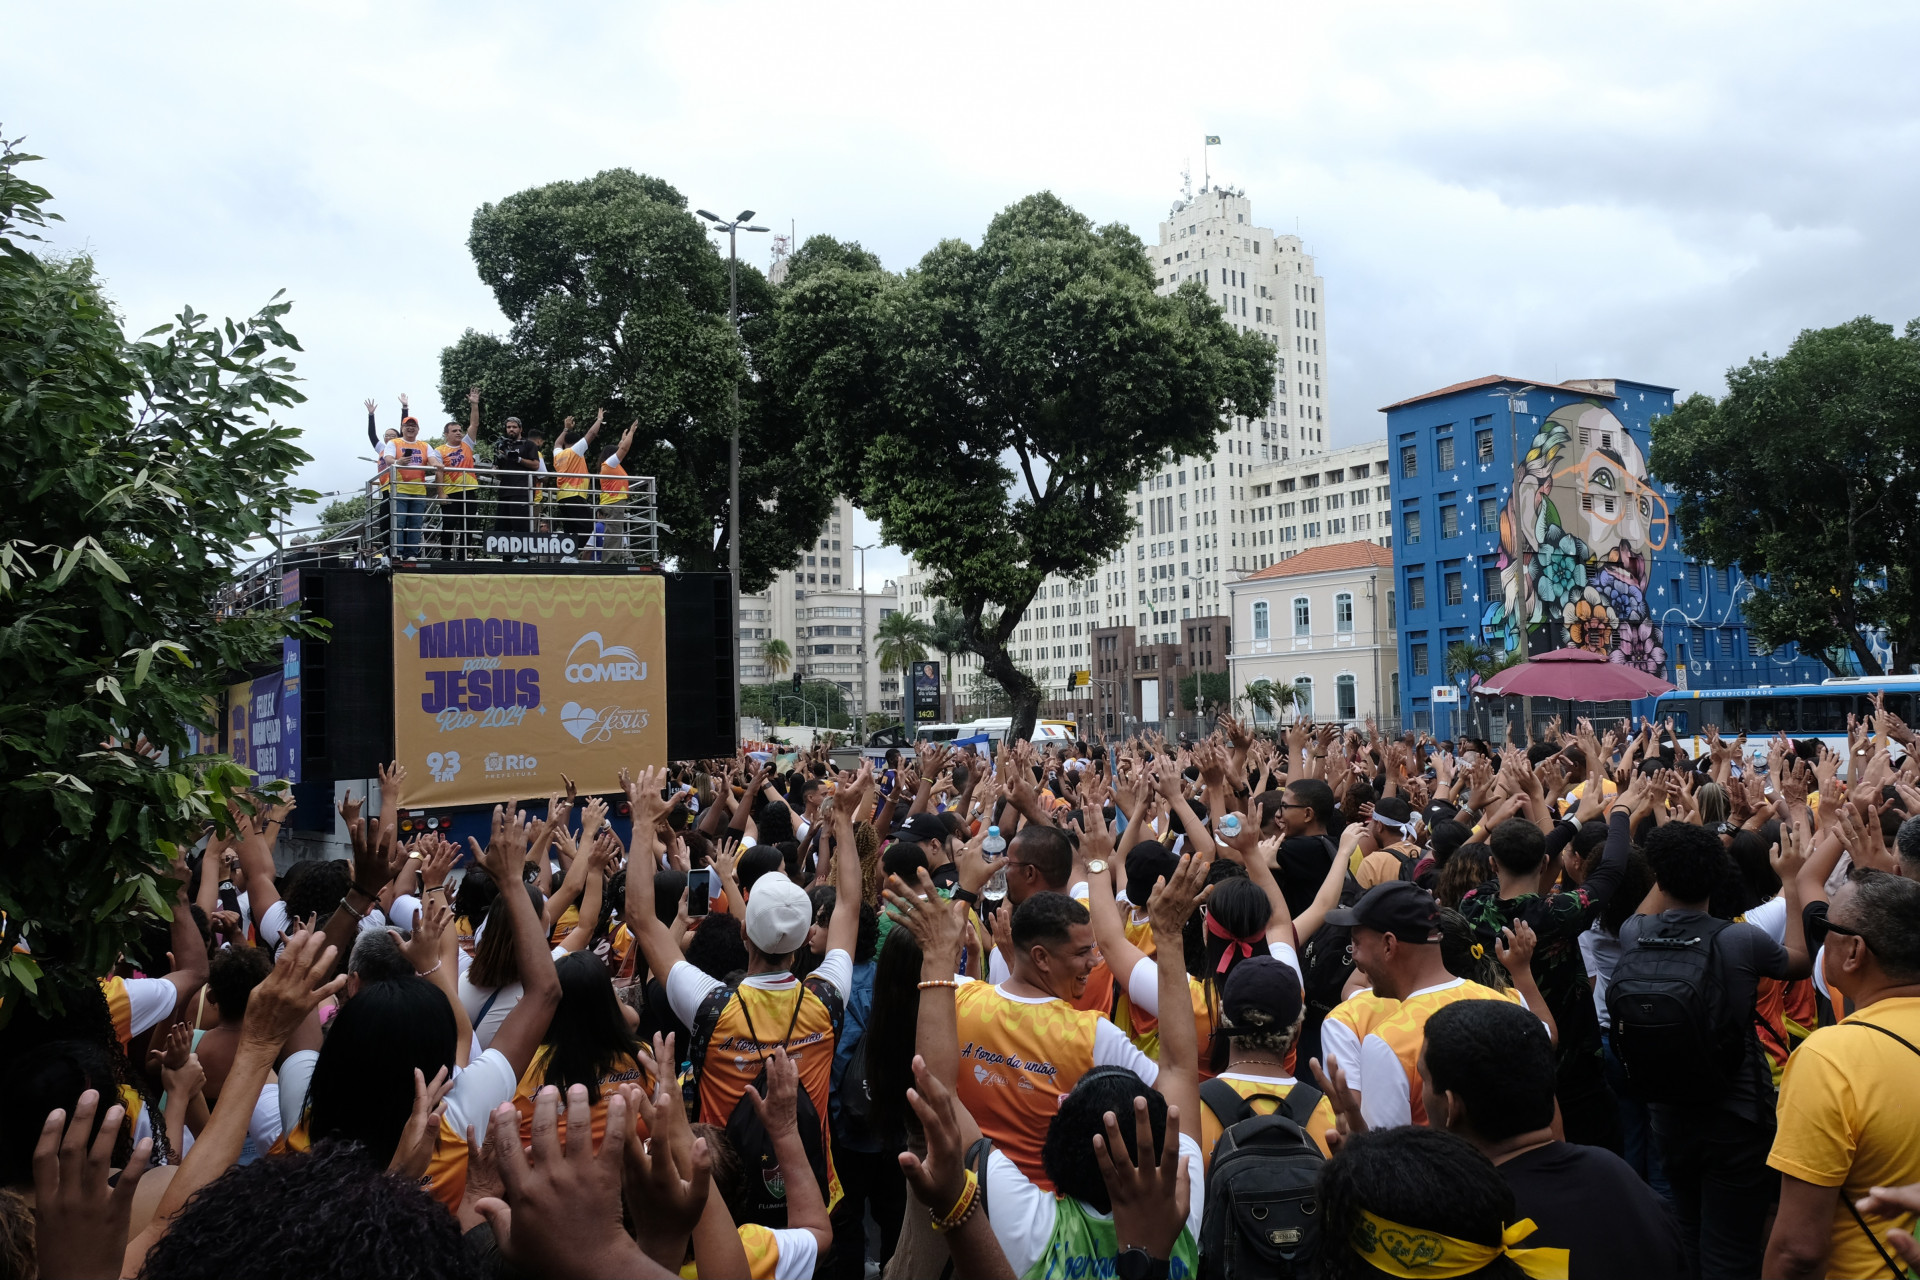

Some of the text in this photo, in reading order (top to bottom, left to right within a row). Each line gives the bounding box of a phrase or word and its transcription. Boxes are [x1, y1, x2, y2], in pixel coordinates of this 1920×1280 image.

[486, 533, 576, 555] PADILHÃO
[419, 617, 540, 659] MARCHA
[461, 657, 502, 675] para
[564, 661, 648, 684] COMERJ
[421, 667, 540, 714] JESUS
[435, 704, 528, 733] Rio 2024
[588, 705, 650, 743] Jesus
[426, 750, 461, 776] 93
[505, 754, 538, 771] Rio
[434, 771, 455, 783] FM
[485, 771, 538, 779] PREFEITURA
[718, 1036, 734, 1052] A
[791, 1031, 824, 1047] união
[961, 1042, 1057, 1076] A força da união
[608, 1068, 640, 1083] união
